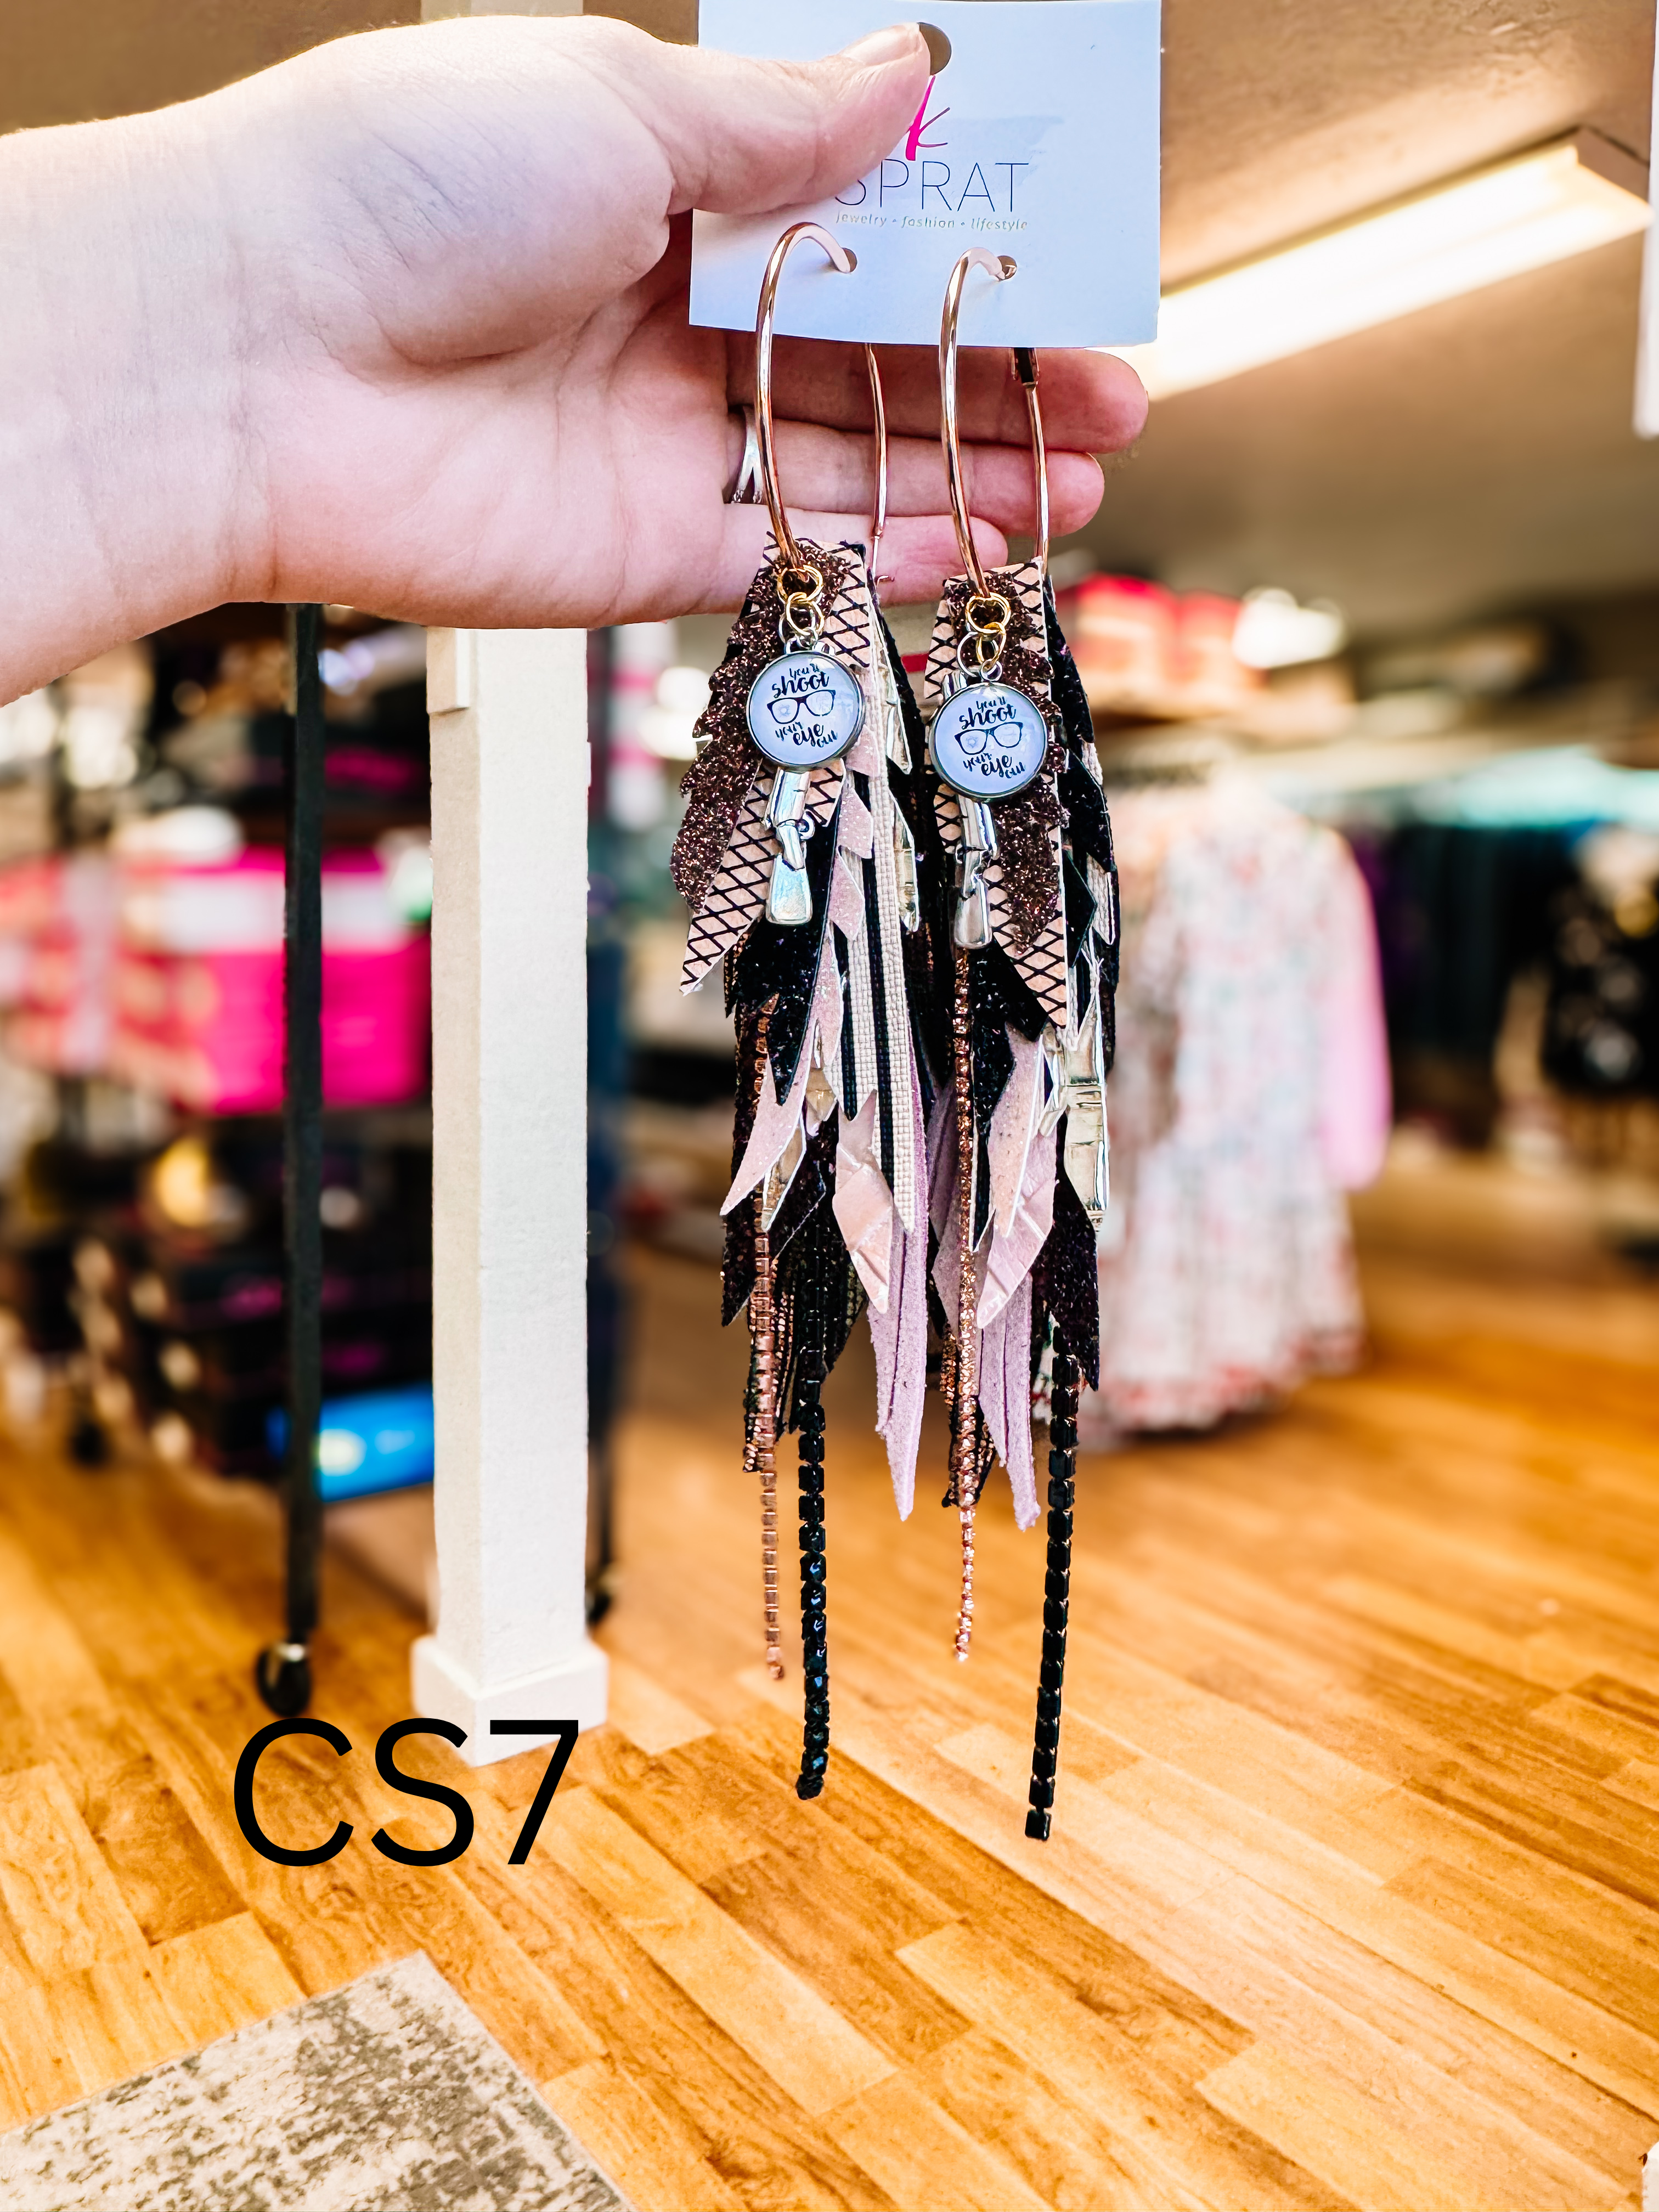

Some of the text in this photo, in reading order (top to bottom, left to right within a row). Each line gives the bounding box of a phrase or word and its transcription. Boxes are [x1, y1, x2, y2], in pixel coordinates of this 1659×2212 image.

[836, 211, 1028, 232] jewelry fashion lifestyle
[772, 671, 830, 698] shoot
[959, 704, 1017, 730] shoot
[775, 721, 838, 748] your eye out
[963, 753, 1025, 778] your eye out
